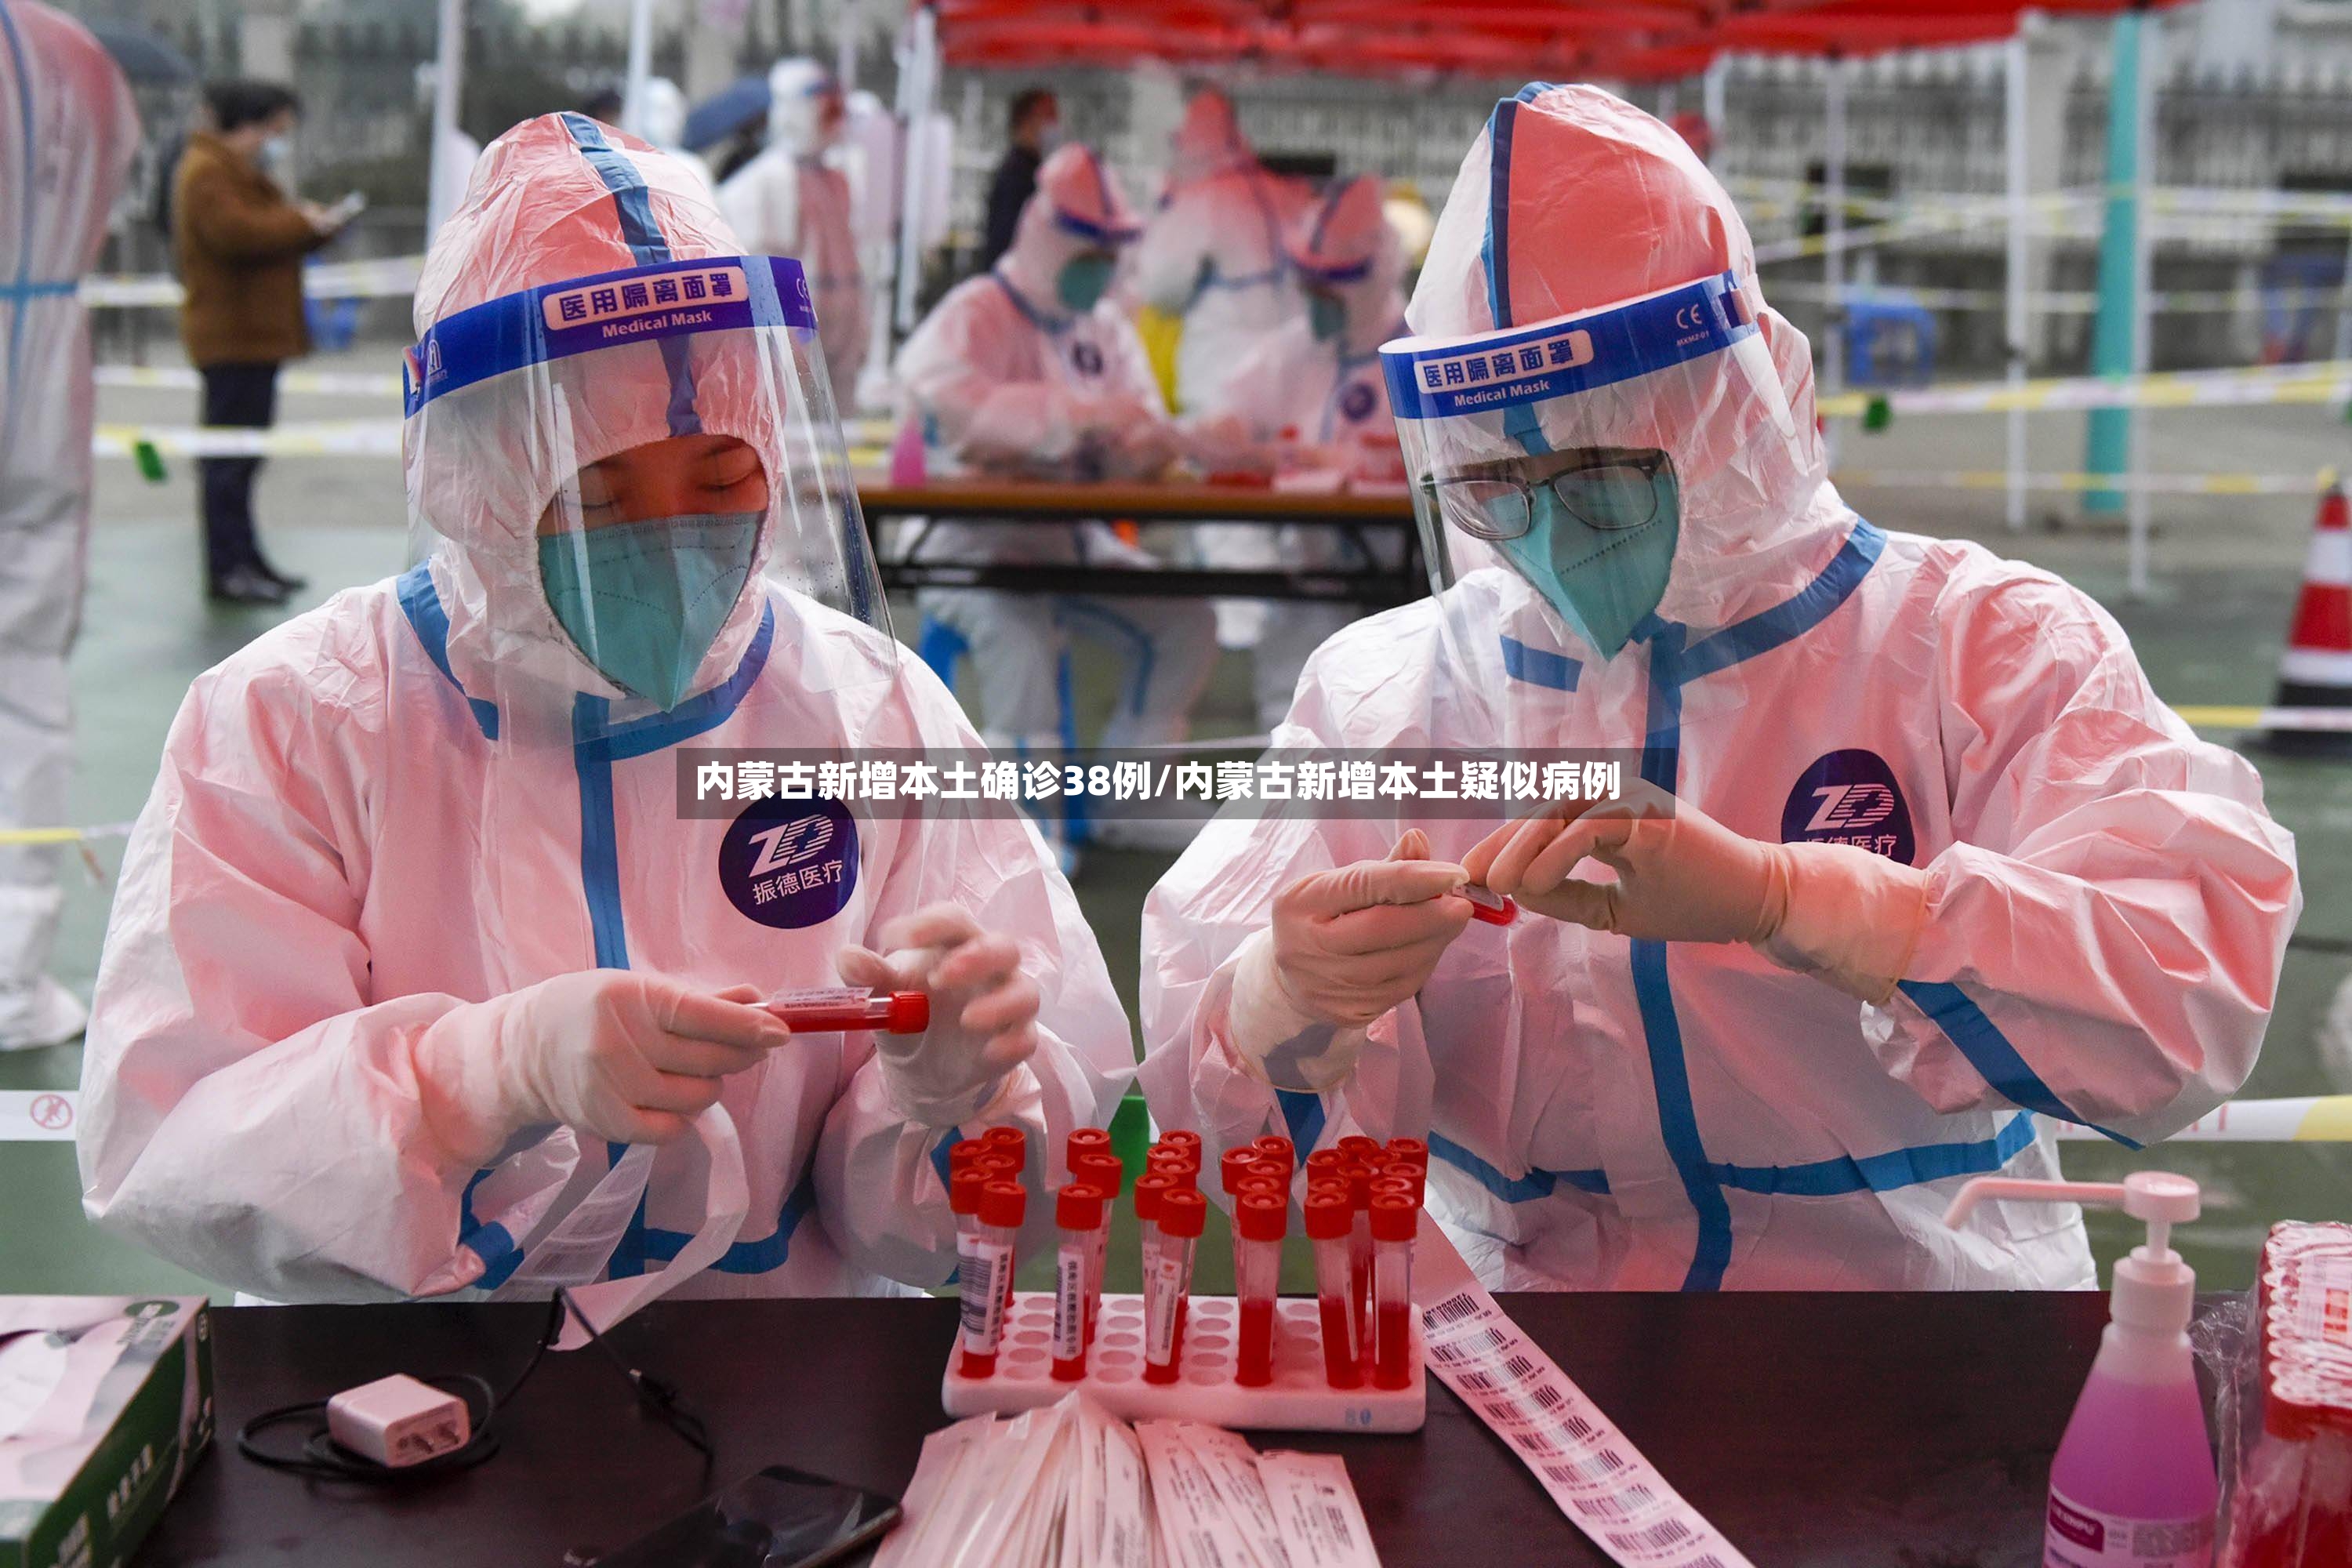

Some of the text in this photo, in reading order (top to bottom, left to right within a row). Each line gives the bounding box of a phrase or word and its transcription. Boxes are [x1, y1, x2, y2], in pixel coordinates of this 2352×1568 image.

[559, 272, 732, 321] 医用隔离面罩
[602, 310, 712, 338] Medical Mask
[1423, 339, 1573, 388] 医用隔离面罩
[1454, 379, 1550, 408] Medical Mask
[1806, 834, 1896, 857] 医疗
[752, 859, 843, 905] 振德医疗
